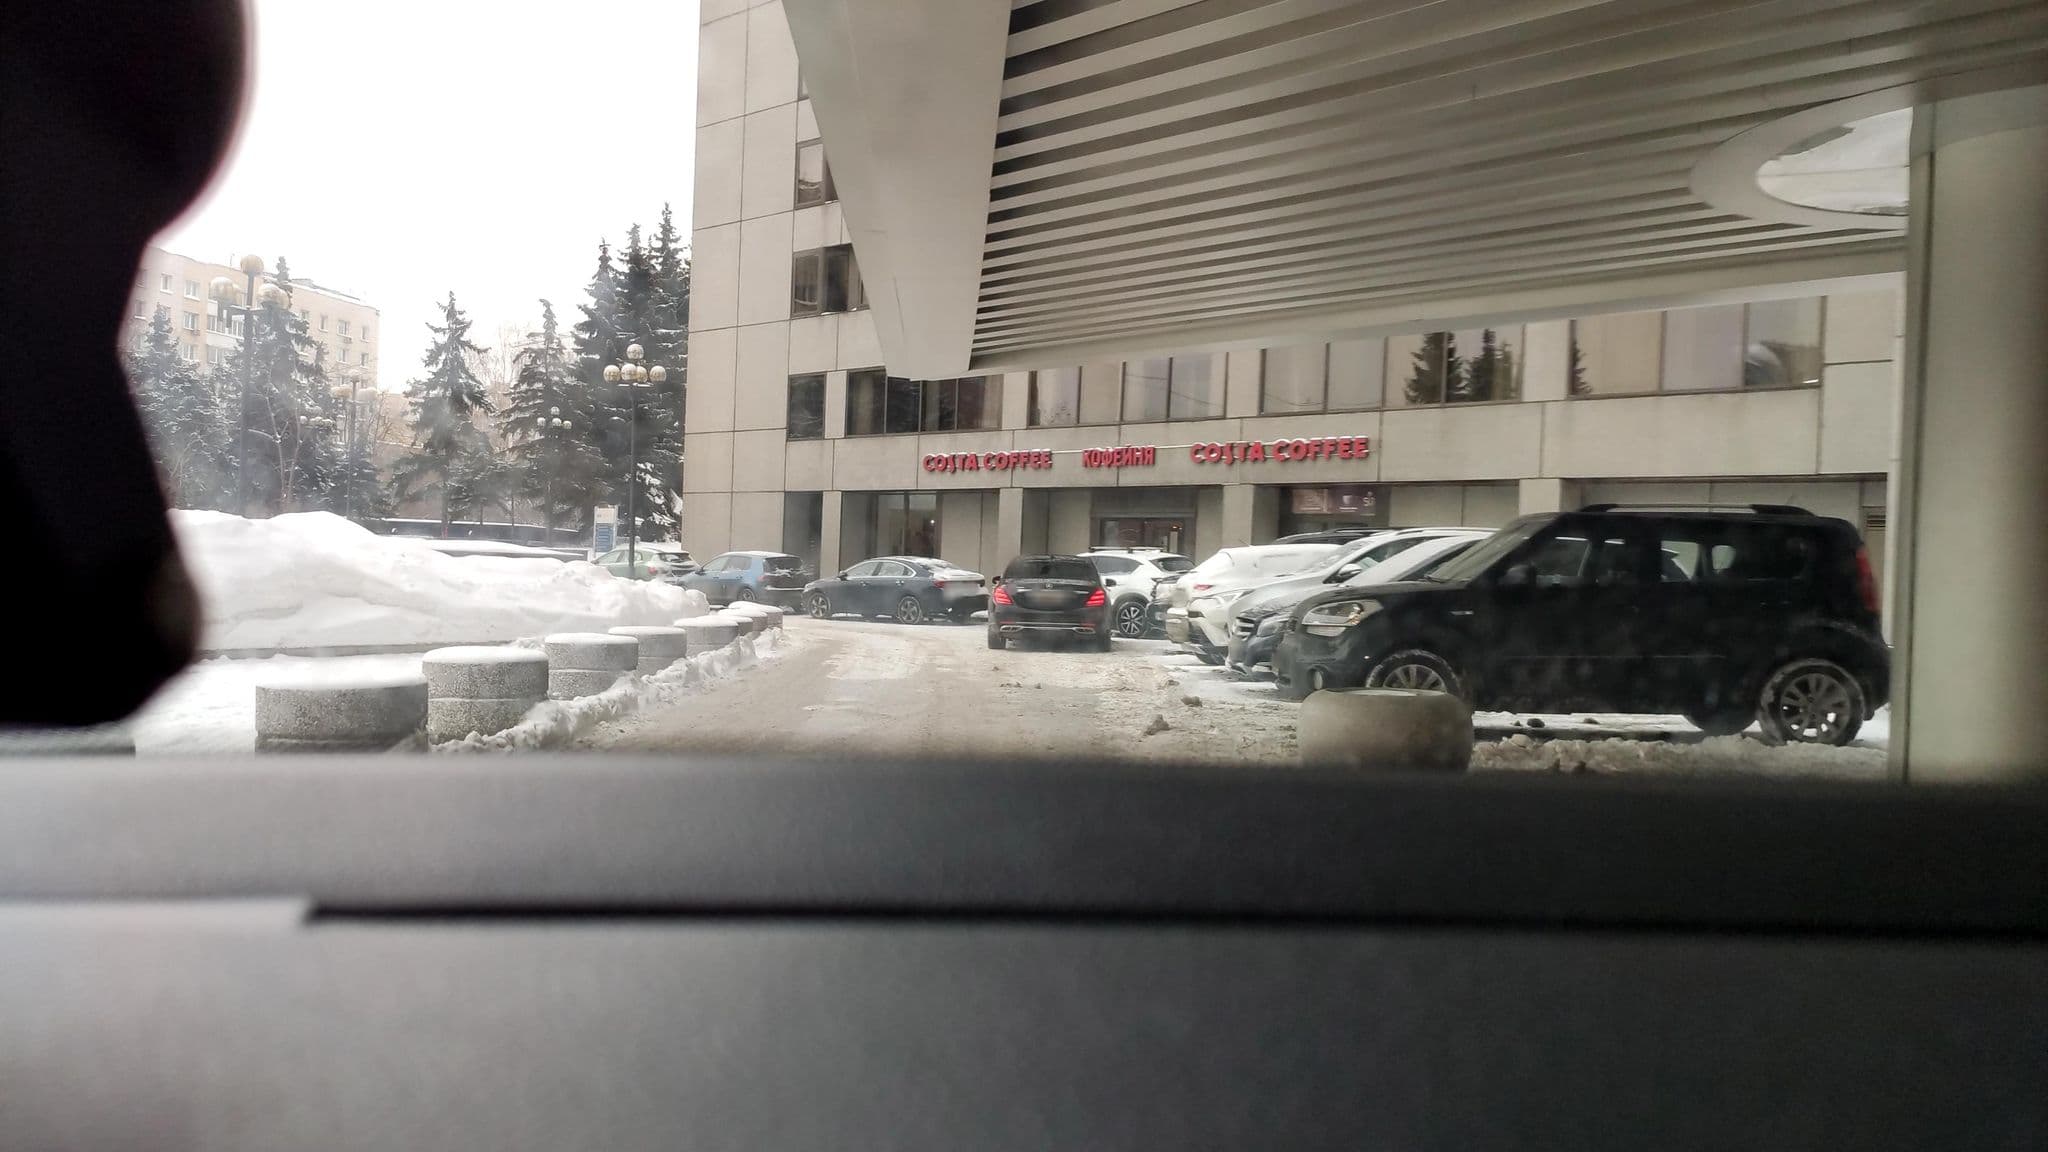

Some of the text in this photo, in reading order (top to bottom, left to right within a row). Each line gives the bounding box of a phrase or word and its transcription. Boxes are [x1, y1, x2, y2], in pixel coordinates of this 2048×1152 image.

[922, 450, 1052, 473] COSTA COFFEE
[1081, 445, 1156, 469] КОФЕЙНЯ
[1189, 437, 1368, 466] COSTA COFFEE
